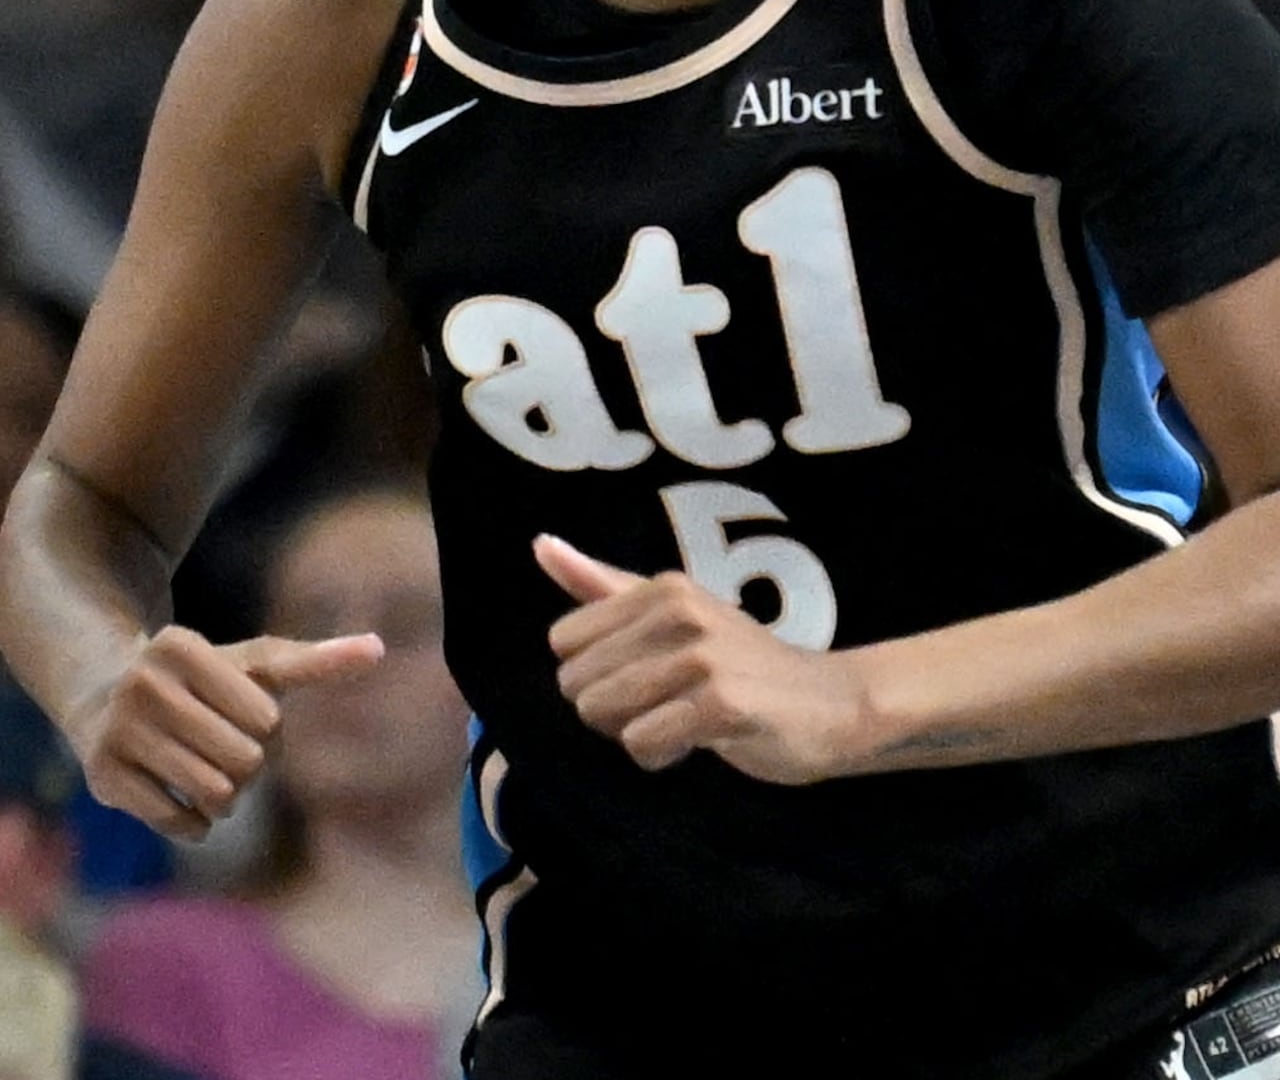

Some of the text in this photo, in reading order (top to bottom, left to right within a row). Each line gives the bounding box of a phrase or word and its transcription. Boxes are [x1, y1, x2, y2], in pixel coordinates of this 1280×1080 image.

[731, 77, 884, 128] Albert
[442, 167, 912, 471] atl
[658, 480, 838, 652] 5
